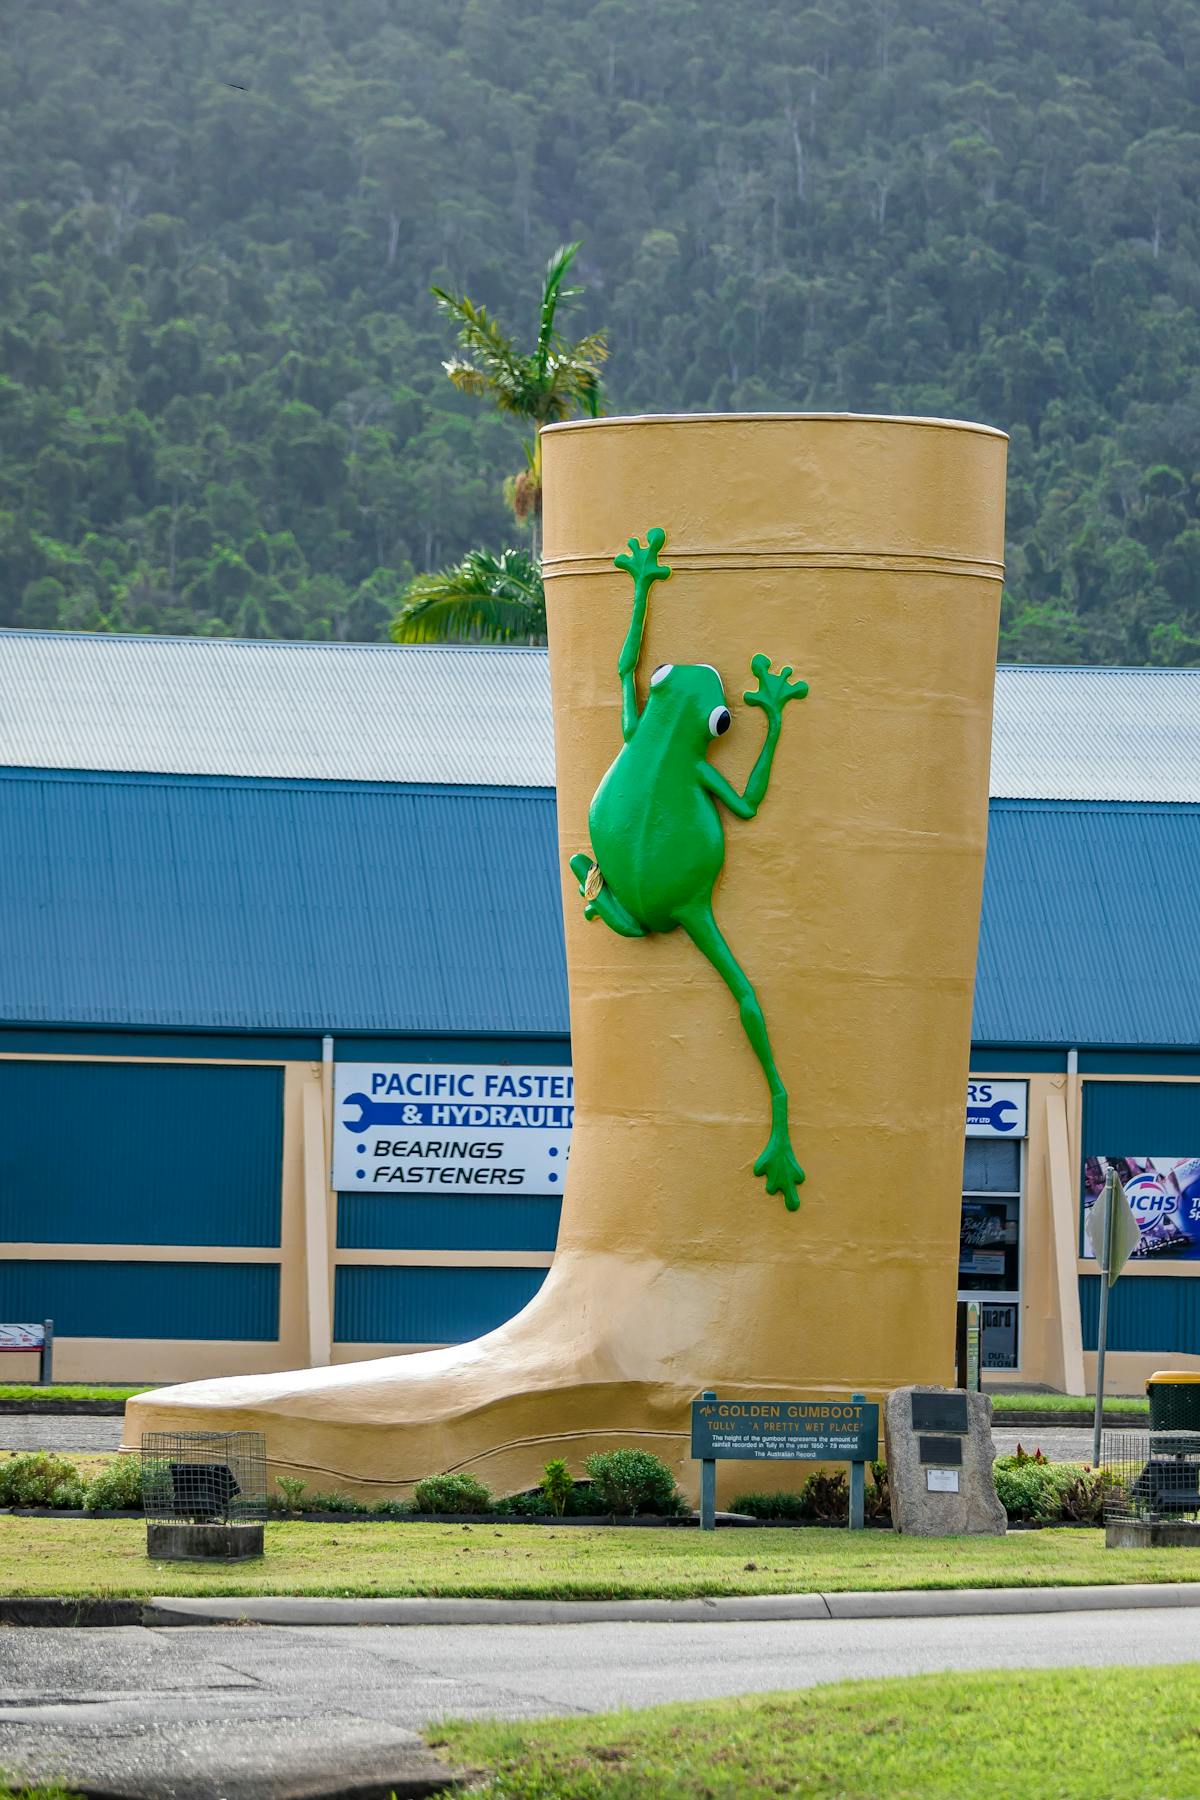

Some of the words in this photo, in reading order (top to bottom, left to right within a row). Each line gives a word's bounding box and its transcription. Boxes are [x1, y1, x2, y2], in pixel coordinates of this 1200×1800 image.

[371, 1073, 474, 1097] PACIFIC
[402, 1105, 423, 1124] &
[432, 1106, 574, 1127] HYDRAULI
[374, 1141, 504, 1158] BEARINGS
[373, 1166, 525, 1185] FASTENERS
[718, 1405, 780, 1417] GOLDEN
[787, 1406, 863, 1419] GUMBOOT
[707, 1421, 736, 1430] TULLY
[764, 1422, 800, 1432] PRETTY
[805, 1423, 825, 1432] WET
